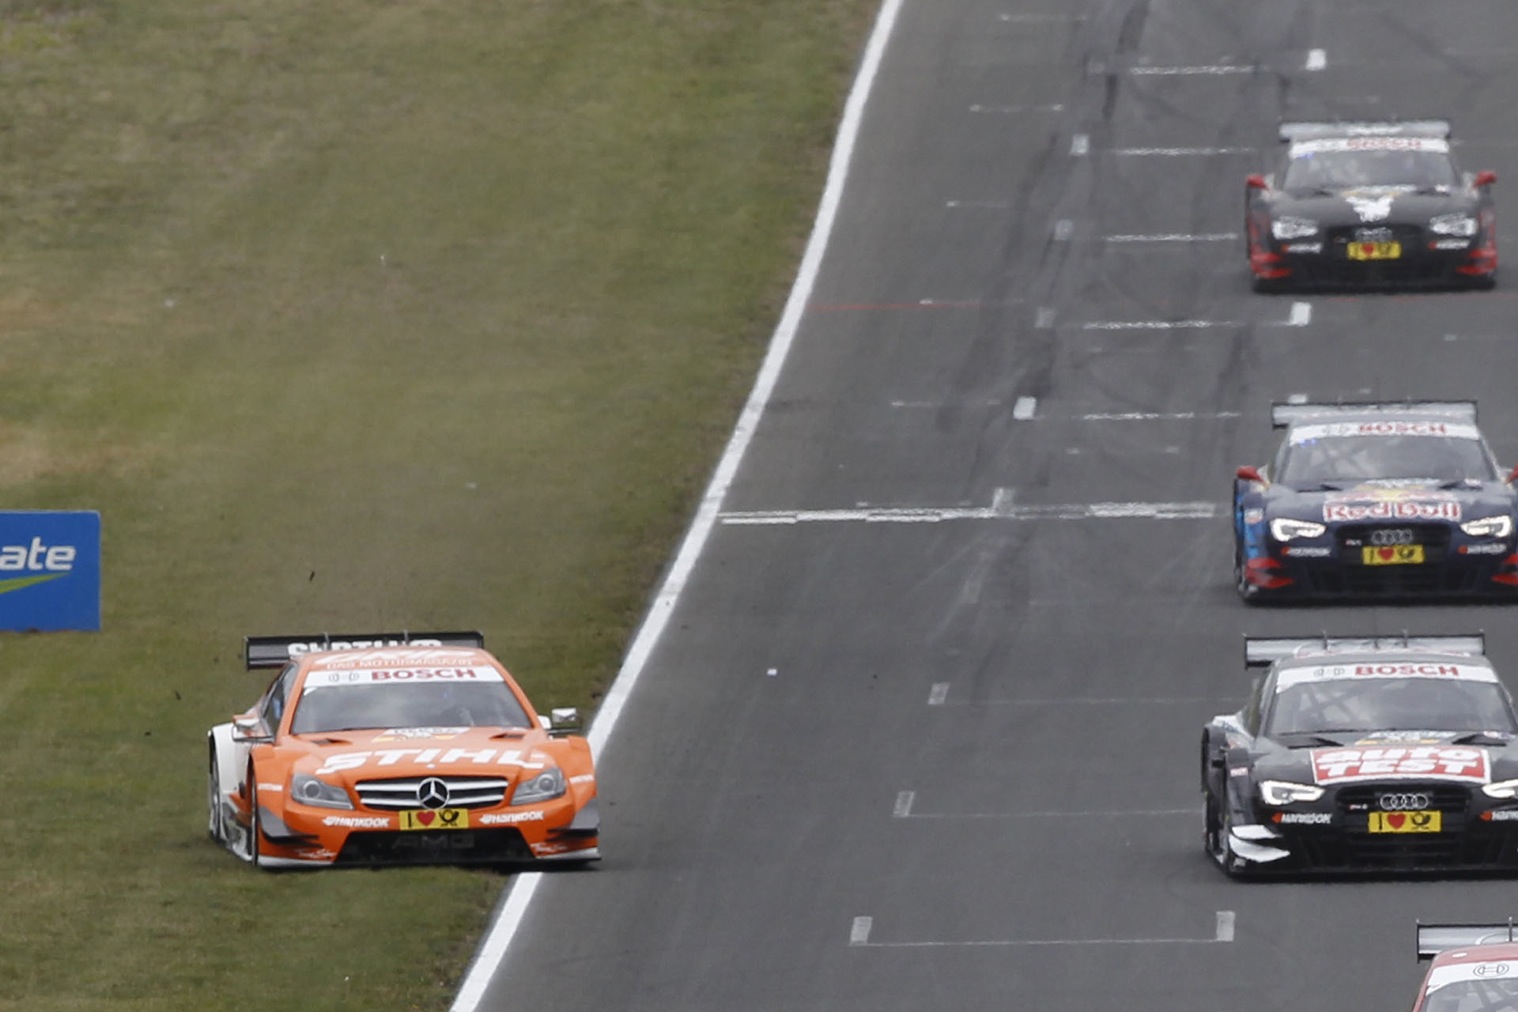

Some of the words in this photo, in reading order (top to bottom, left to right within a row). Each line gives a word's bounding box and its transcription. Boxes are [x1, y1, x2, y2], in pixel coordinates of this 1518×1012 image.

[0, 536, 76, 571] ate
[371, 668, 477, 681] BOSCH
[1354, 664, 1460, 677] BOSCH
[315, 747, 545, 775] STIHL
[1318, 758, 1483, 777] TEST
